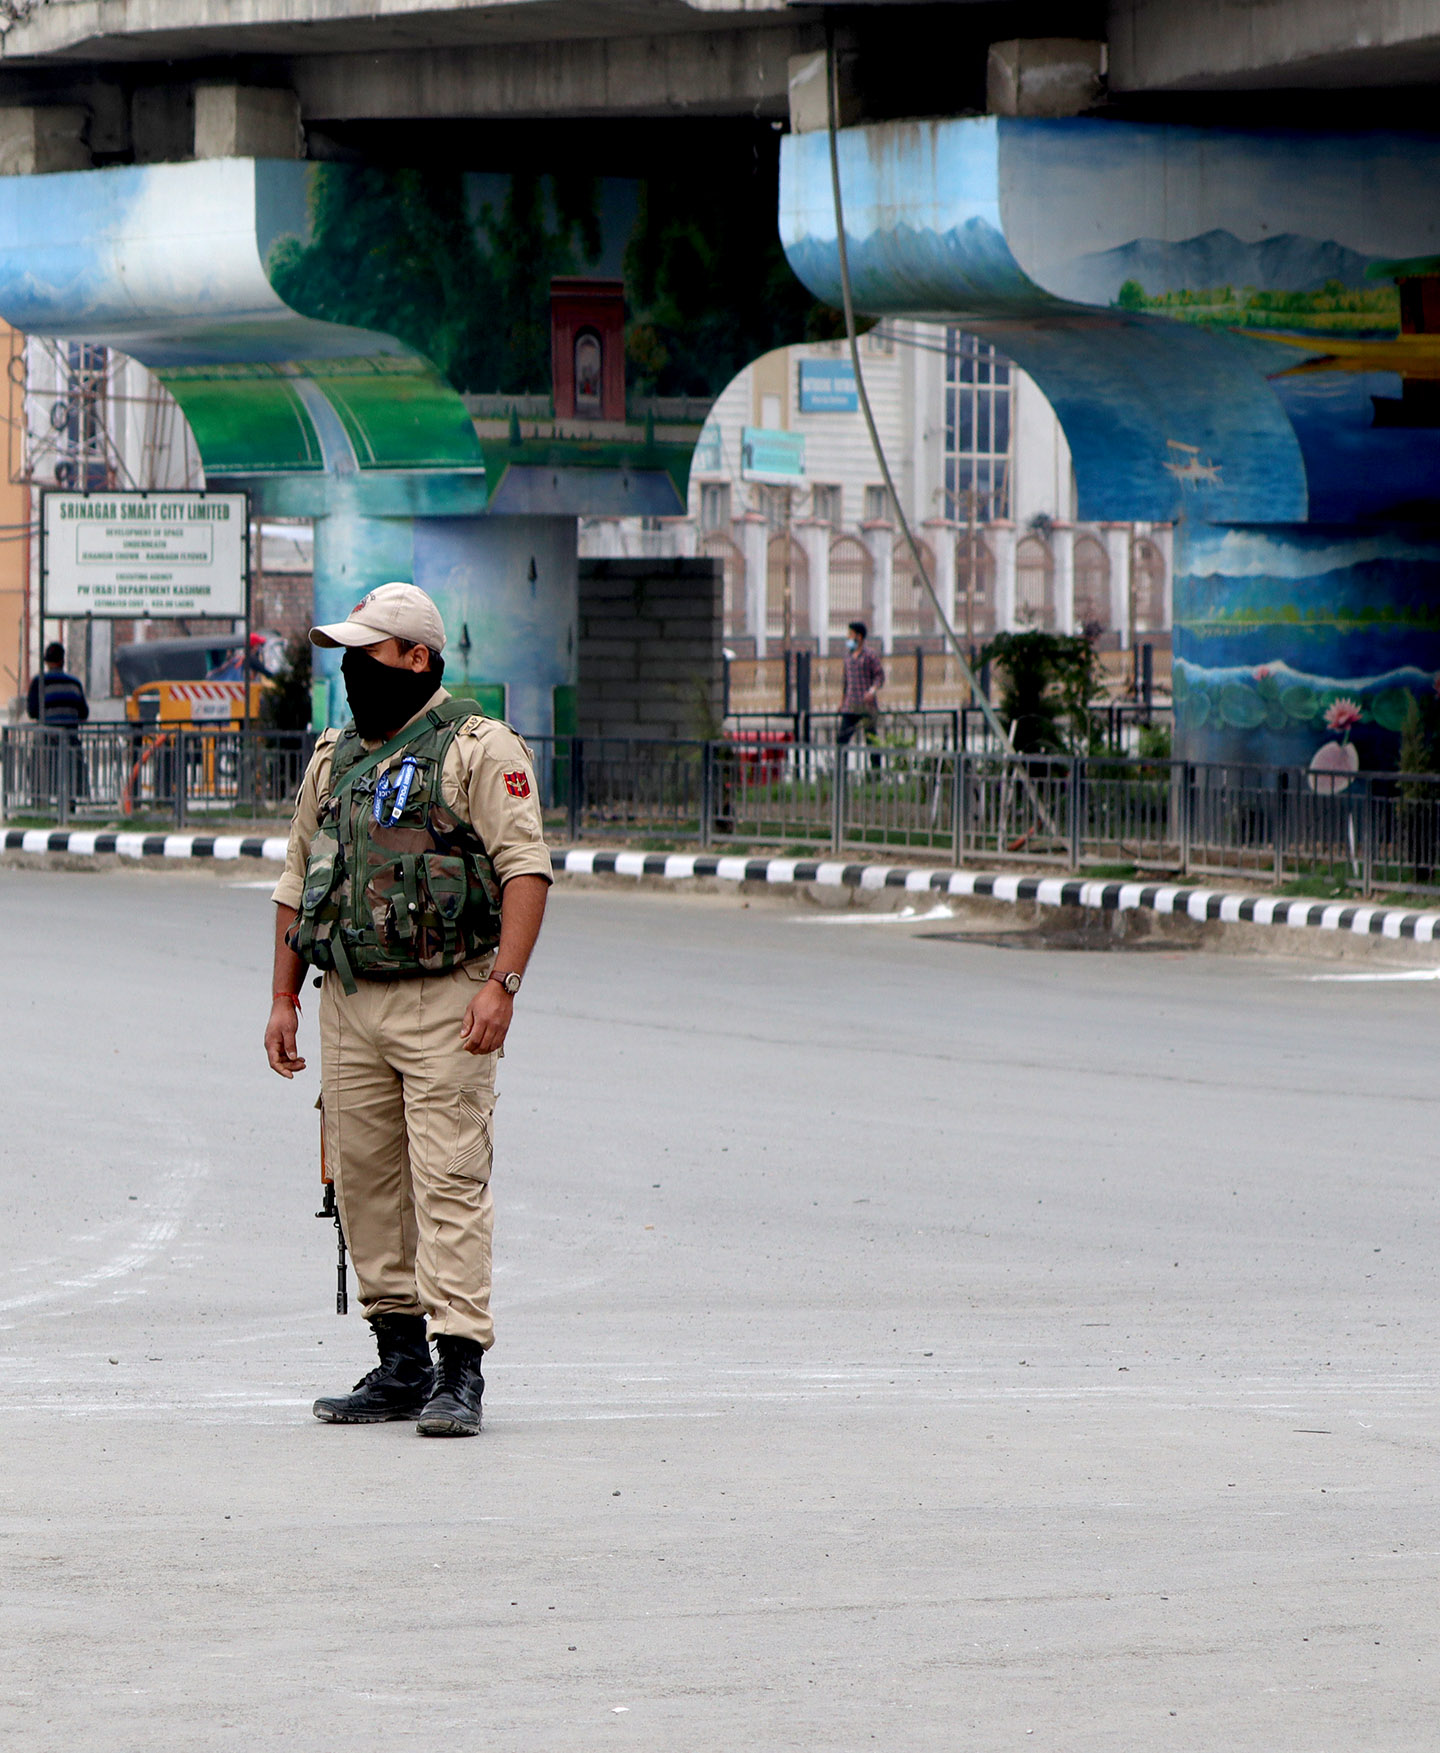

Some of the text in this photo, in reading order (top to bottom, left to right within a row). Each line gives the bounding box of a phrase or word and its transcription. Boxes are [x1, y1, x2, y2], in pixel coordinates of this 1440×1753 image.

[59, 502, 231, 521] SRINAGAR SMART CITY LIMITED
[118, 585, 171, 595] DEPARTMENT
[172, 585, 212, 595] KASHMIR
[396, 785, 409, 808] POLICE
